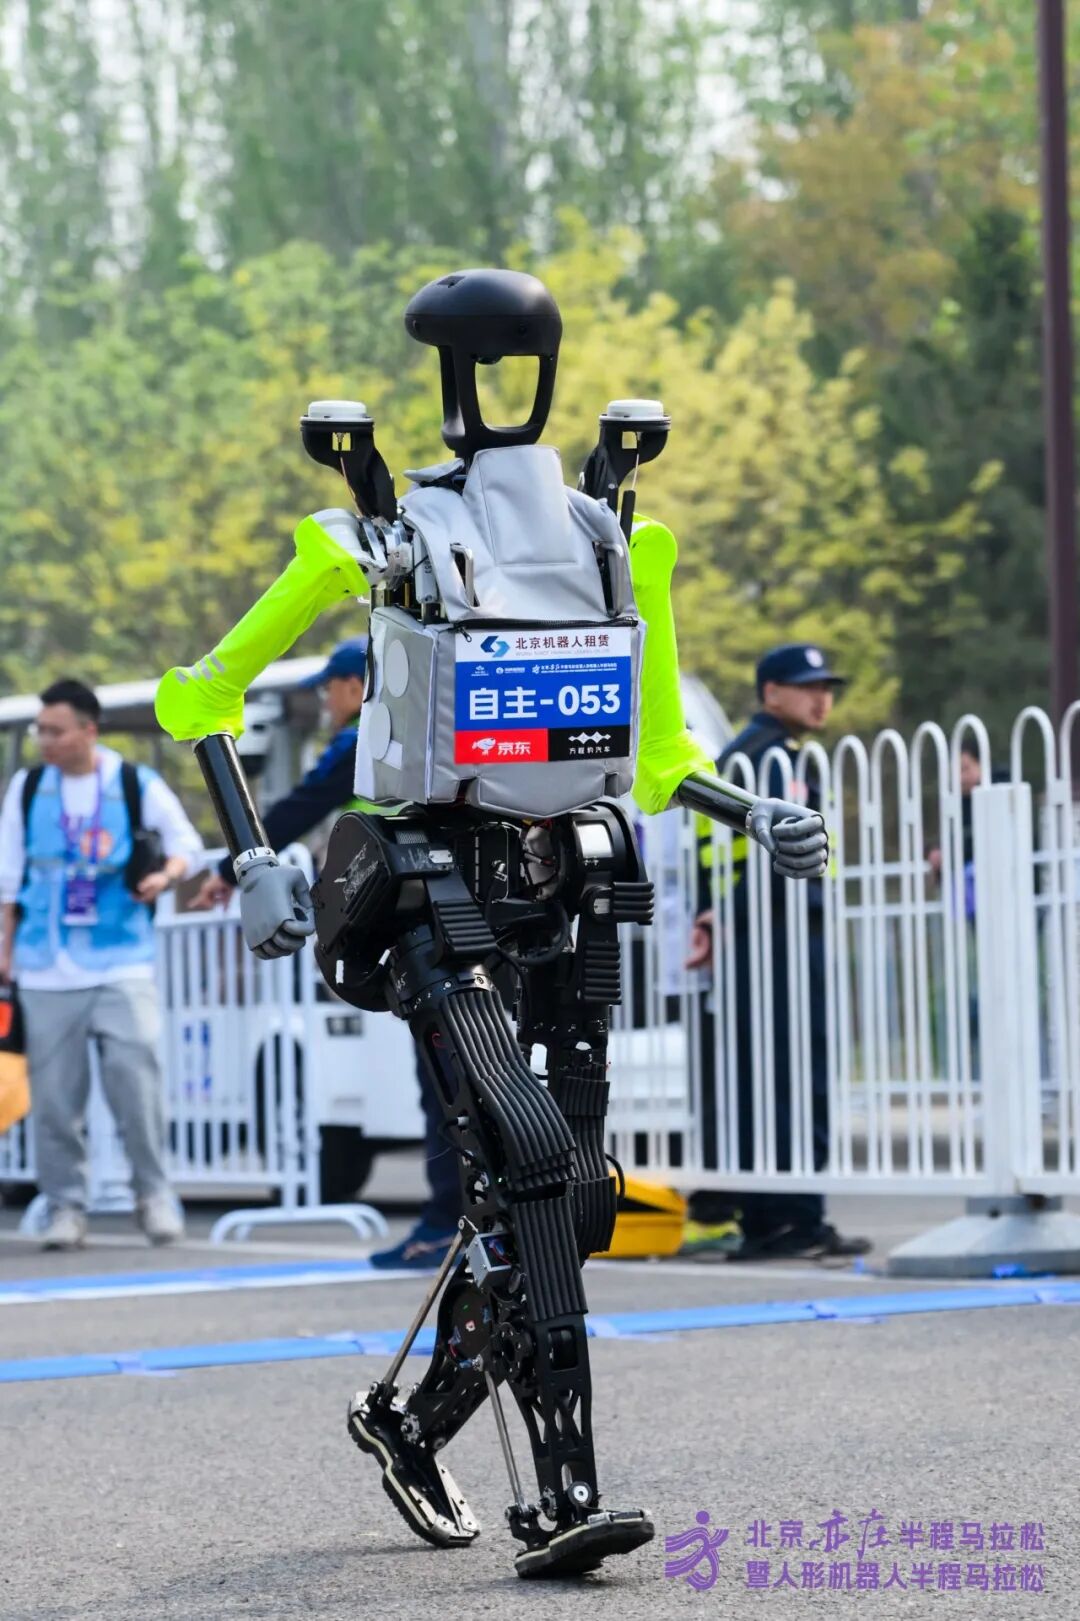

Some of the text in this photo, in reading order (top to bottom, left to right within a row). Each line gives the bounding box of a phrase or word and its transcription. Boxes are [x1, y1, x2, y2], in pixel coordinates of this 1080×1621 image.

[515, 634, 610, 650] 北京机器人租赁
[469, 684, 621, 721] 自主-053
[497, 741, 531, 756] 京东
